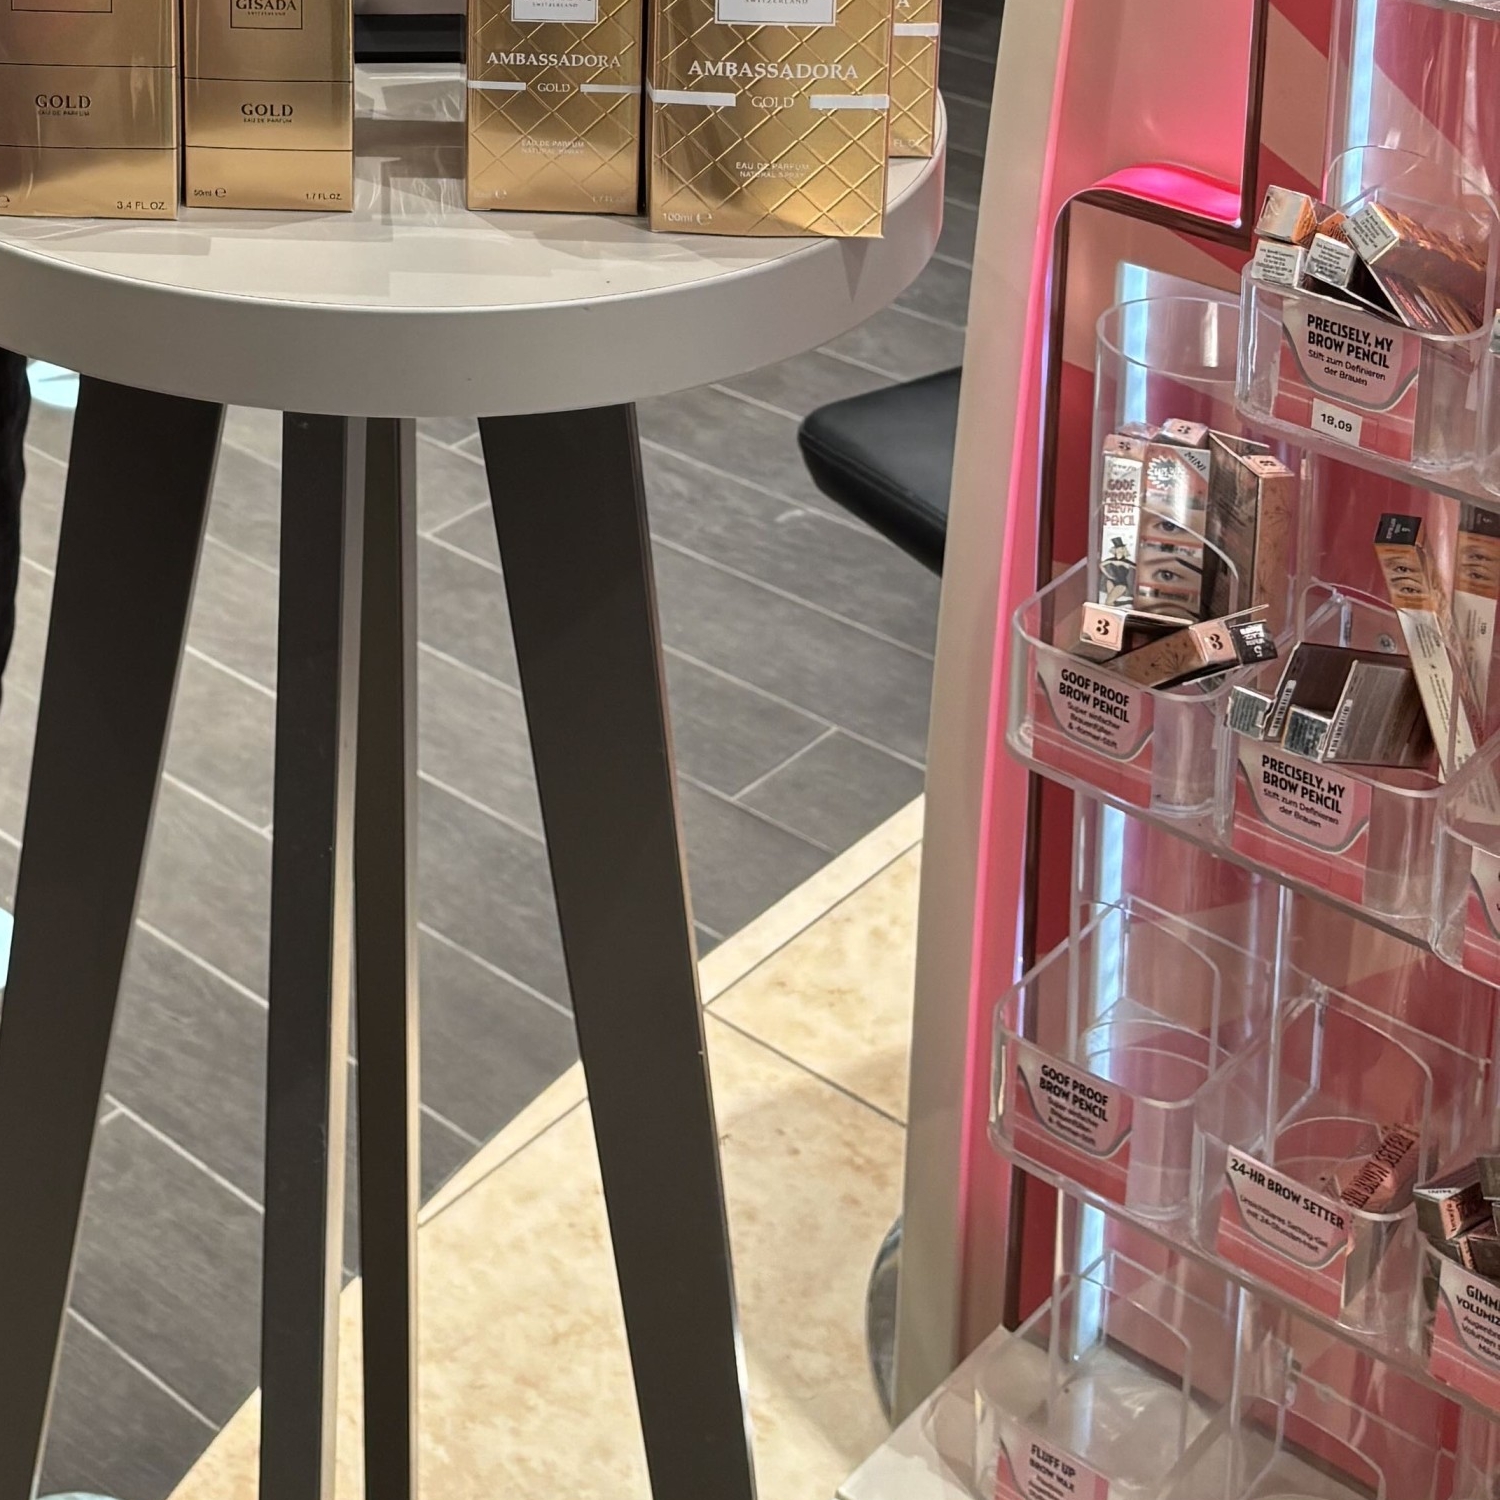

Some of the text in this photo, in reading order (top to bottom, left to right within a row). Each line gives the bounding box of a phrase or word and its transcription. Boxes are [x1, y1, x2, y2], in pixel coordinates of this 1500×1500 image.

[487, 52, 621, 69] AMBASSADORA
[688, 60, 859, 80] AMBASSADORA
[537, 83, 571, 93] GOLD
[35, 94, 91, 109] GOLD
[241, 103, 293, 117] GOLD
[751, 96, 794, 108] GOLD
[194, 189, 212, 197] 50ml
[117, 201, 132, 210] 3.4
[1307, 314, 1393, 352] PRECISELY, MY
[1307, 330, 1390, 369] BROW PENCIL
[1308, 349, 1386, 381] Stift zum Definieren
[1324, 366, 1368, 387] der Brauen
[1320, 412, 1352, 433] 18,09
[1184, 451, 1207, 471] MINI
[1061, 668, 1129, 707] GOOF PROOF
[1059, 682, 1130, 723] BROW PENCIL
[1262, 754, 1345, 798] PRECISELY, MY
[1263, 771, 1342, 814] BROW PENCIL
[1042, 1064, 1108, 1106] GOOF PROOF
[1040, 1077, 1070, 1100] BROW
[1072, 1094, 1108, 1122] PENCIL
[1231, 1158, 1265, 1187] 24-HR
[1267, 1179, 1301, 1204] BROW
[1303, 1198, 1344, 1229] SETTER
